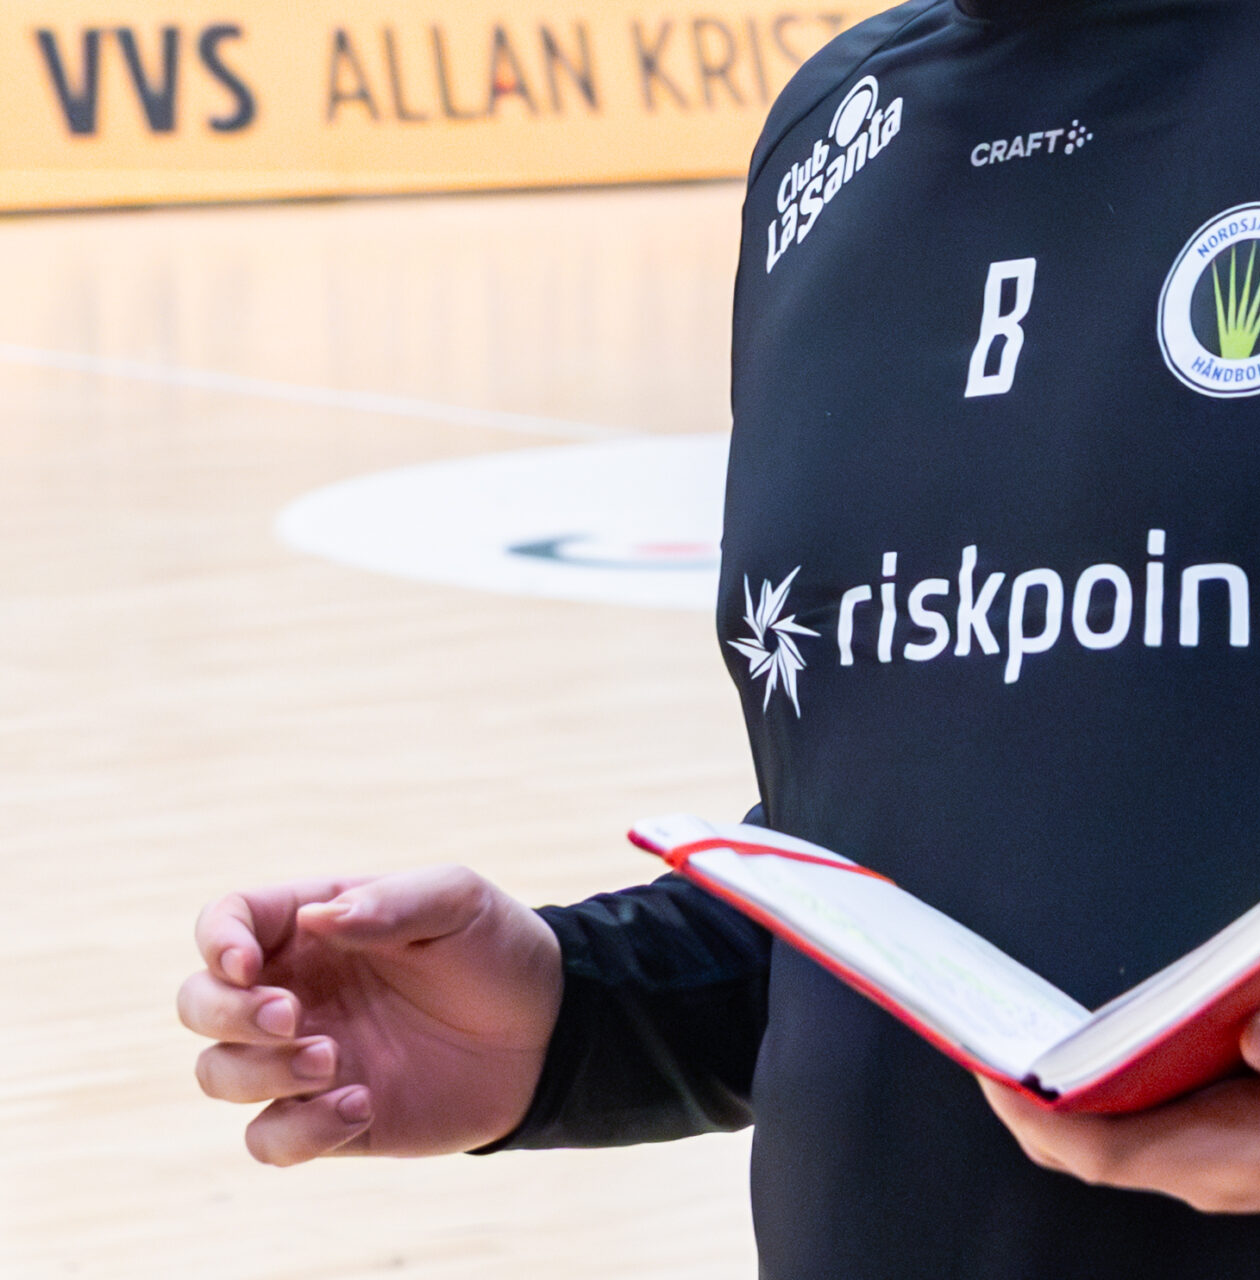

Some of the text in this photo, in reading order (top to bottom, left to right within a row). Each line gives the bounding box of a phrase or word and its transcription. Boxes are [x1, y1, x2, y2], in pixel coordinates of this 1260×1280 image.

[36, 23, 257, 136] VVS
[326, 20, 602, 124] ALLAN
[777, 139, 830, 214] Club
[970, 128, 1065, 167] CRAFT
[964, 257, 1037, 398] B
